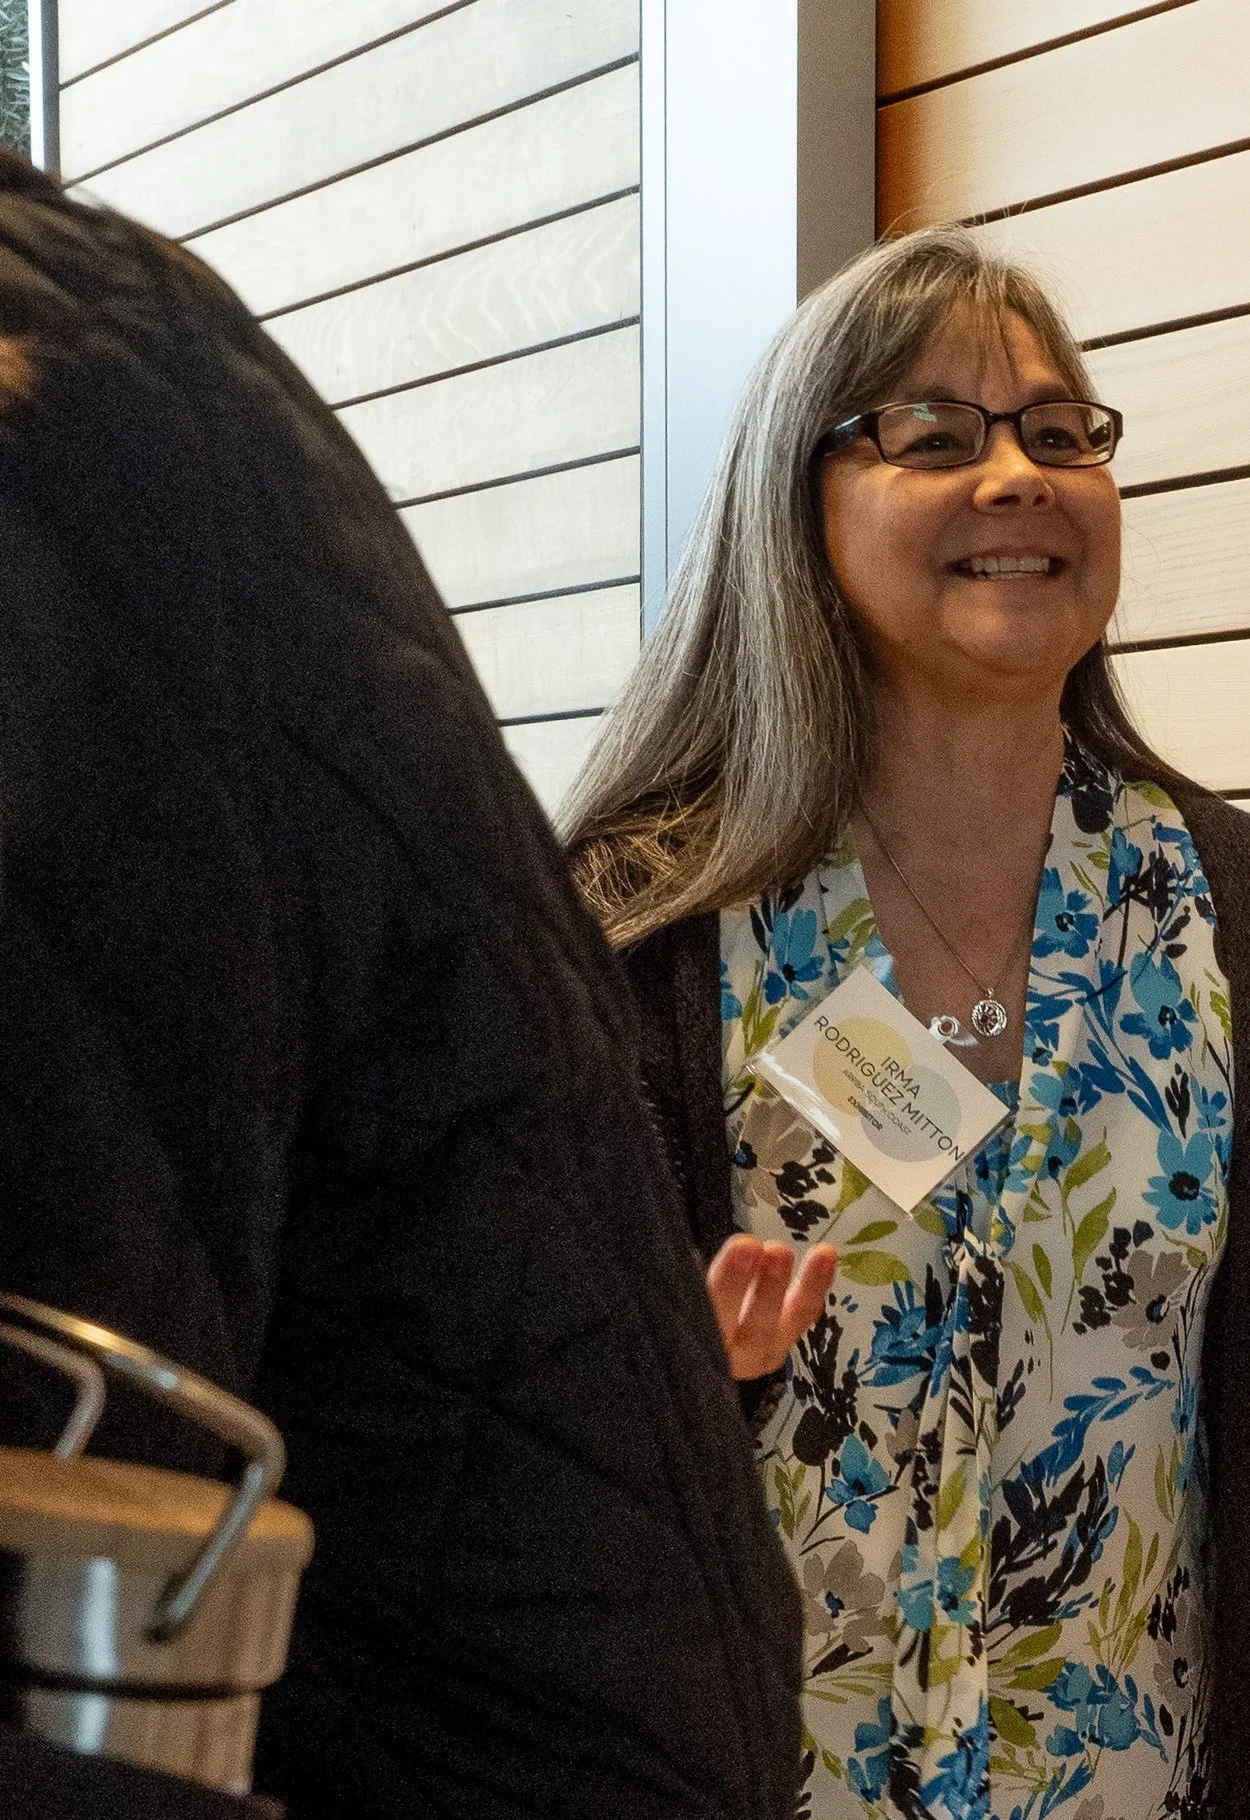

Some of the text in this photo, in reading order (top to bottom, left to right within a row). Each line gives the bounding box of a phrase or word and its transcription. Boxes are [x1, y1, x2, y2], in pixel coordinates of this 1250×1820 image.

[814, 1015, 966, 1162] RODRIGUEZ MITTON
[881, 1056, 921, 1099] IRMA
